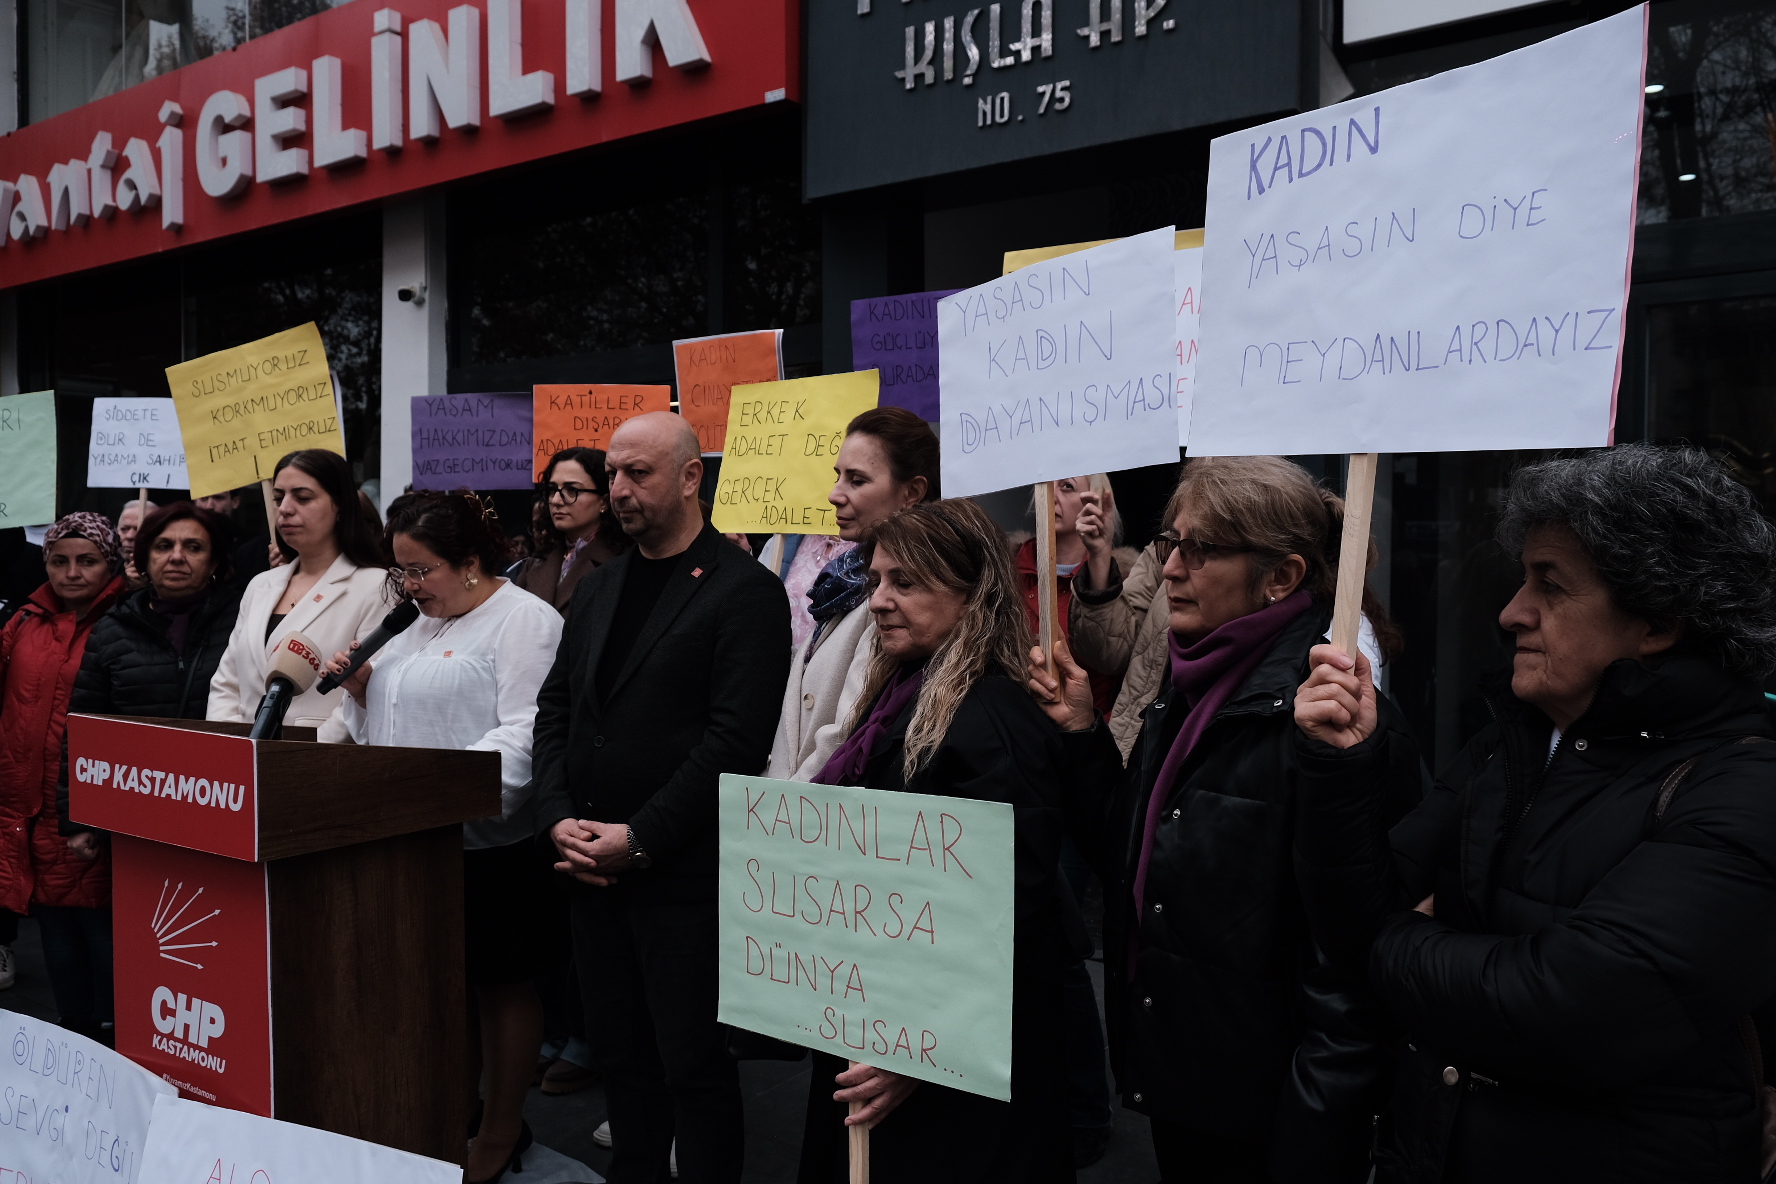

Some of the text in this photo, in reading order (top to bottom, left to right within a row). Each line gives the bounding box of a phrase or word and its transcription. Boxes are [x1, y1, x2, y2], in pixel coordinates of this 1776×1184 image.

[1036, 80, 1071, 115] 75
[1246, 106, 1381, 200] KADIN
[1243, 189, 1548, 289] YAŞASIN DİYE
[868, 298, 938, 322] KADINI
[955, 260, 1090, 337] YAŞASIN
[689, 343, 736, 367] KADIN
[987, 310, 1113, 379] KADIN
[1241, 307, 1616, 387] MEYDANLARDAYIZ
[191, 349, 310, 398] SUSMUYORUZ
[210, 382, 331, 426] KORKMUYORUZ
[549, 389, 644, 412] KATİLLER
[573, 415, 629, 433] DIŞAR
[739, 398, 806, 427] ERKEK
[960, 372, 1172, 454] DAYANIŞMASI
[138, 432, 156, 447] DE
[419, 427, 532, 450] HAKKIMIZDAN
[728, 433, 789, 457] ADALET
[718, 476, 787, 506] GERÇEK
[75, 756, 245, 812] CHP KASTAMONU
[745, 786, 973, 879] KADINLAR
[743, 858, 935, 944] SUSARSA
[746, 935, 866, 1003] DÜNYA
[151, 985, 226, 1048] CHP
[12, 1026, 116, 1109] ÖLDÜREN
[152, 1033, 226, 1074] KASTAMONU
[0, 1086, 69, 1146] SEVGİ
